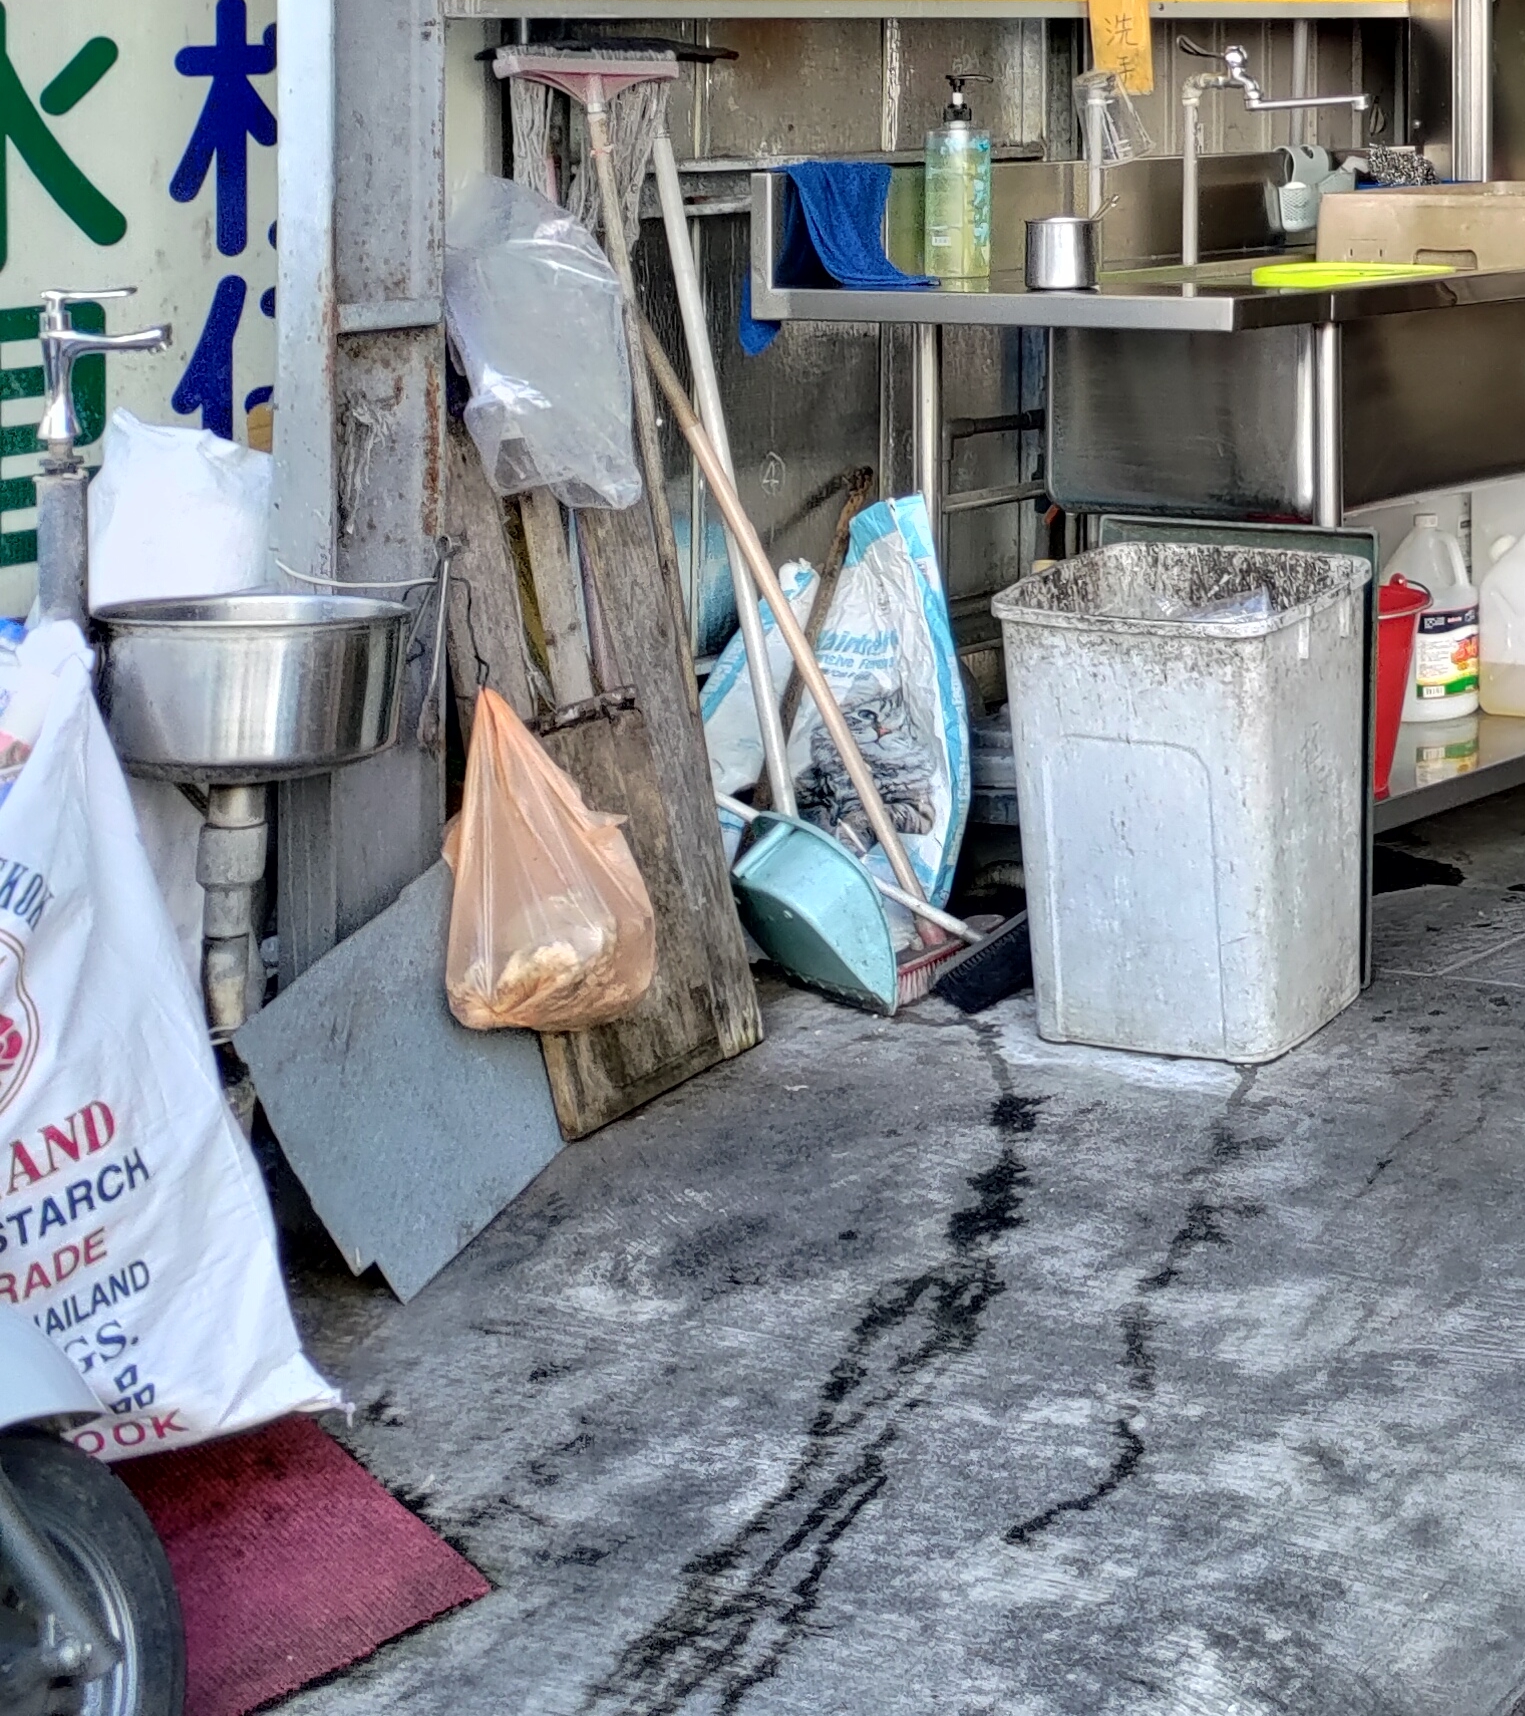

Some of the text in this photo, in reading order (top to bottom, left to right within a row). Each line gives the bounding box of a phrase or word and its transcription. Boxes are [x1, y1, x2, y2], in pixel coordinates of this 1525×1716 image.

[5, 1100, 115, 1196] AND
[0, 1226, 108, 1303] RADE
[34, 1259, 150, 1335] AILAND
